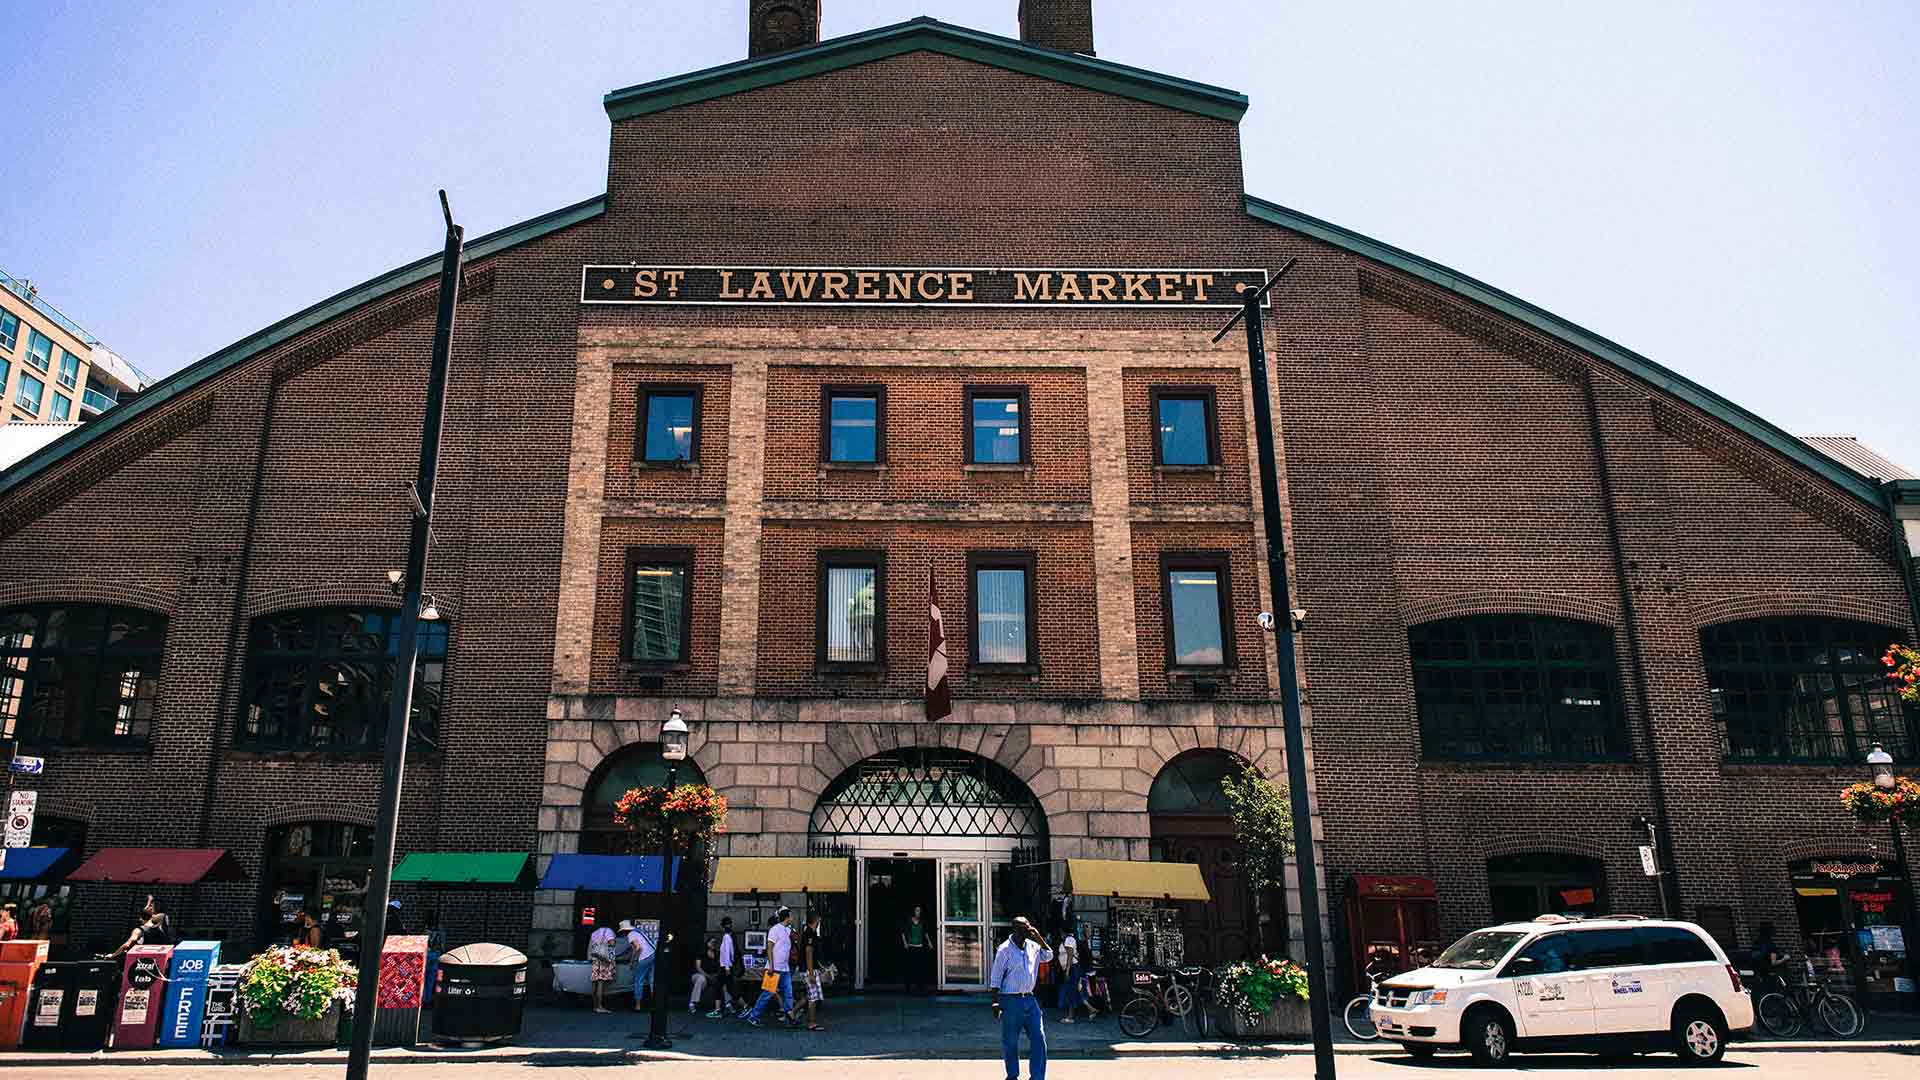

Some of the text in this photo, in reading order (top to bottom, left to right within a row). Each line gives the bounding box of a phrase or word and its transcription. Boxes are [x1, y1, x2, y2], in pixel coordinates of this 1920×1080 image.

[719, 271, 973, 300] LAWRENCE
[1013, 273, 1213, 301] MARKET
[19, 792, 30, 800] NO
[1830, 871, 1850, 880] Pump
[179, 959, 204, 971] JOB
[448, 986, 462, 995] Litter
[174, 987, 194, 1038] FREE
